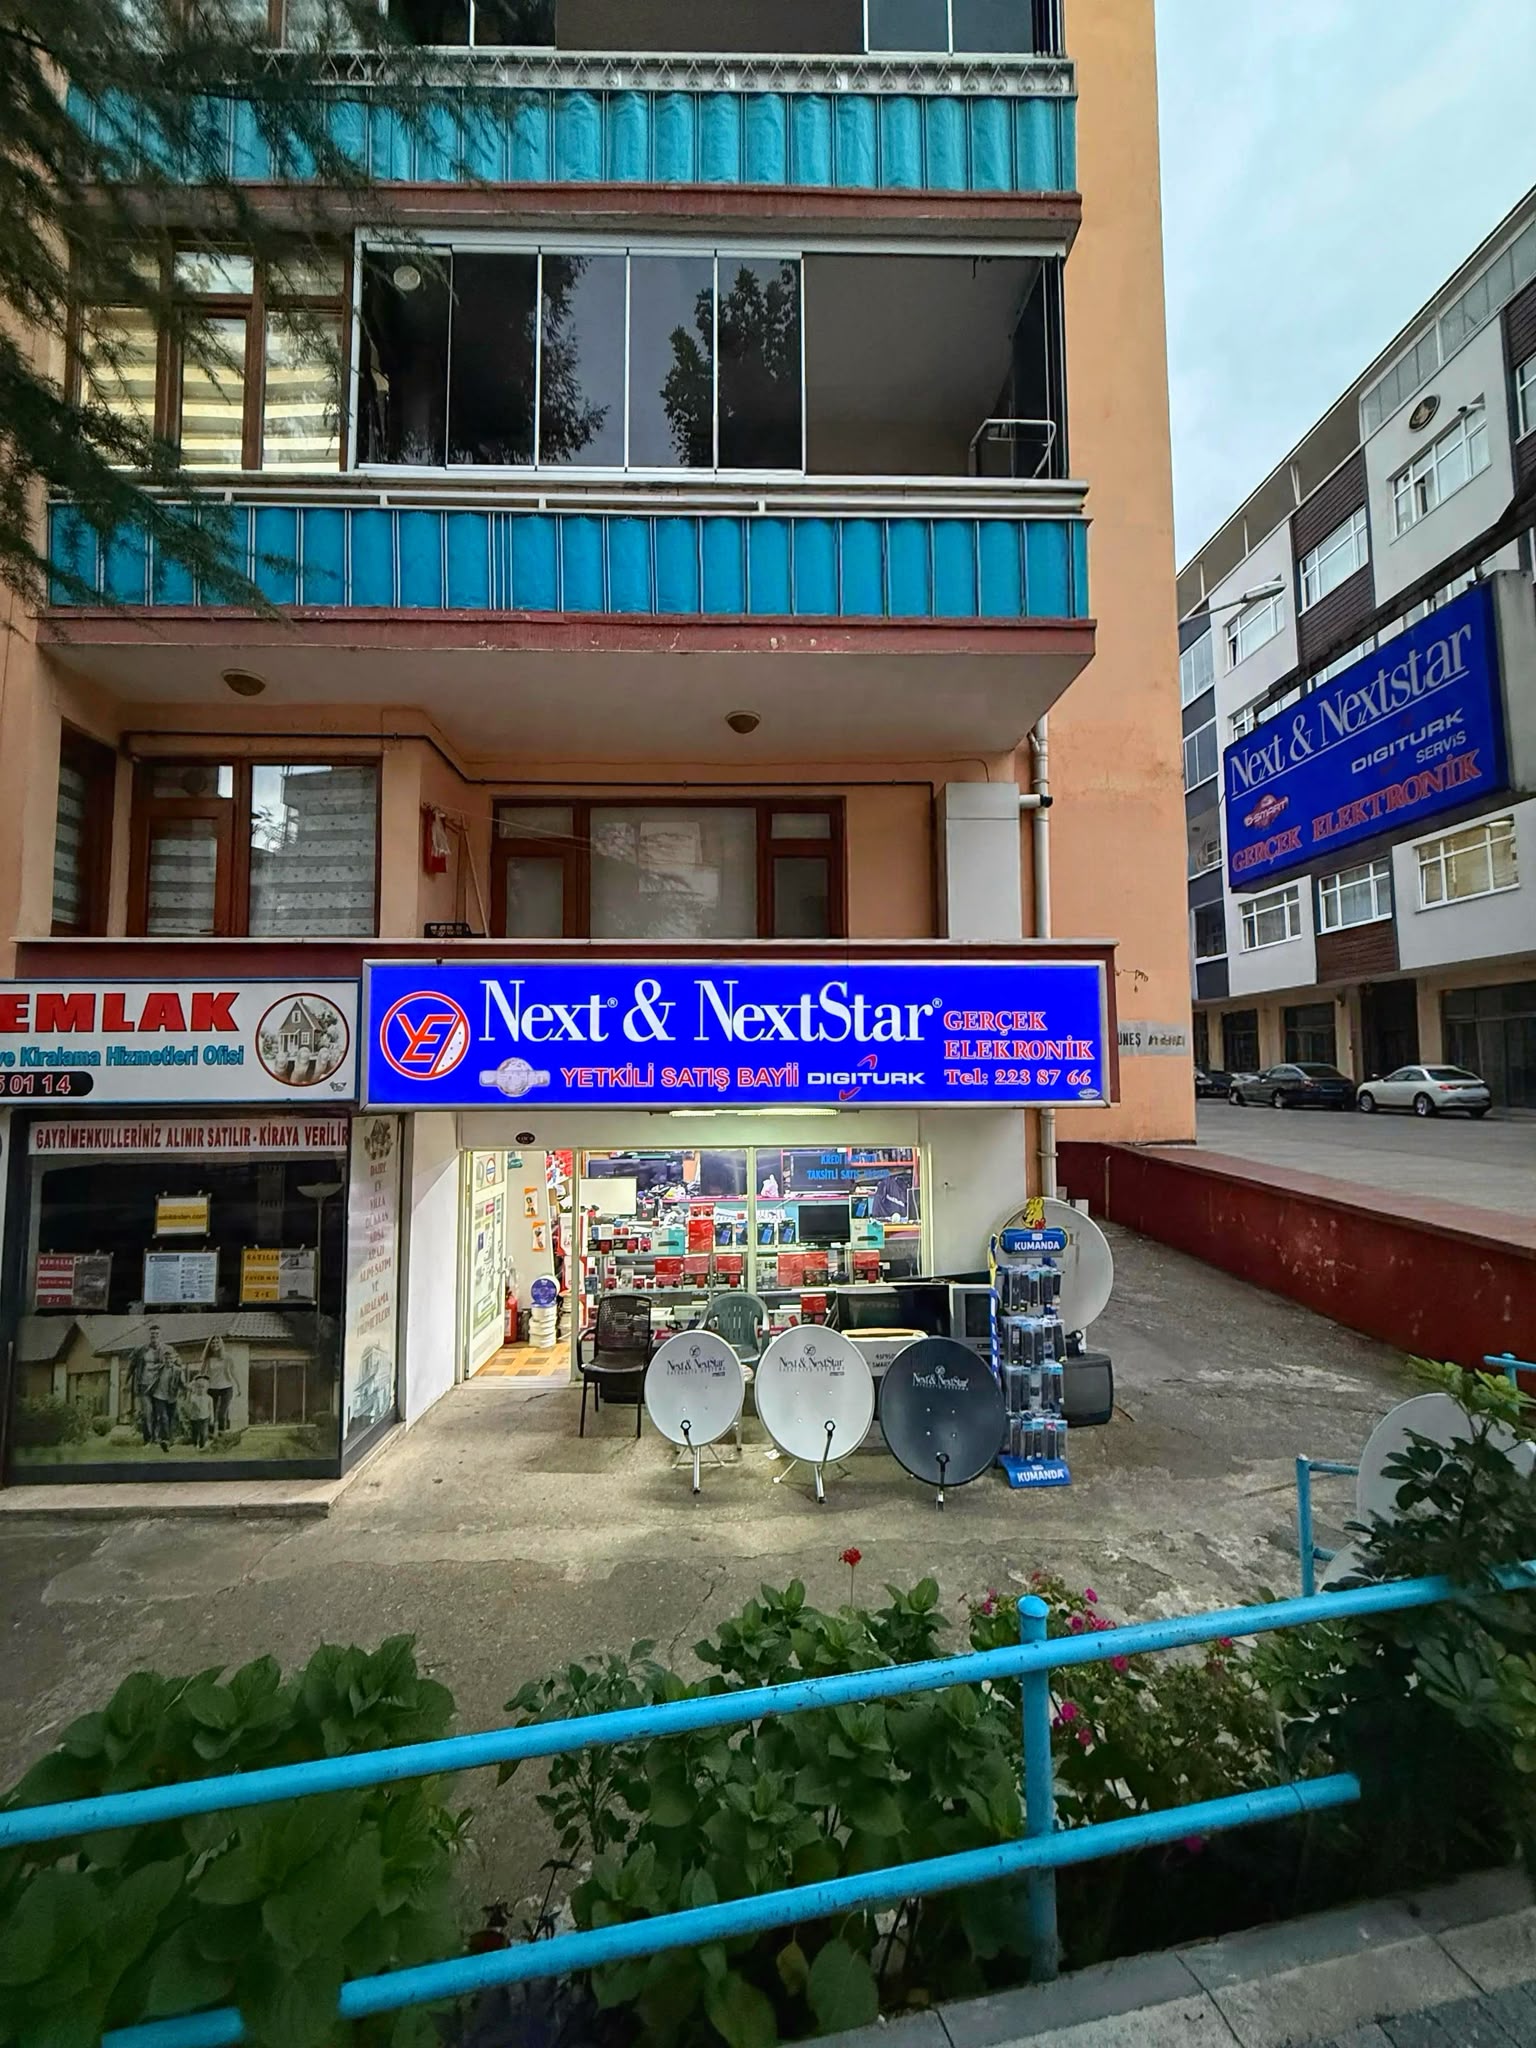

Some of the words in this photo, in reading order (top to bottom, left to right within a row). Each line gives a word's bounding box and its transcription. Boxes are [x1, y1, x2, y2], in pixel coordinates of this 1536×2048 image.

[1351, 708, 1463, 774] DIGITURK
[1230, 734, 1287, 795] Next
[1290, 714, 1313, 762] &
[1232, 825, 1302, 873] GERÇEK
[1312, 749, 1482, 842] ELEKTRONİK
[0, 992, 240, 1033] EMLAK
[622, 979, 676, 1042] &
[943, 1010, 1048, 1036] GERÇEK
[20, 1046, 101, 1067] Kiralama
[106, 1045, 197, 1066] Hizmetleri
[203, 1045, 244, 1066] Ofisi
[943, 1035, 1095, 1060] ELEKRONİK
[9, 1074, 34, 1094] 01
[42, 1074, 71, 1094] 14
[560, 1063, 654, 1087] YETKİLİ
[660, 1067, 730, 1092] SATIŞ
[807, 1072, 926, 1085] DIGITURK
[944, 1068, 989, 1086] Tel:
[994, 1069, 1030, 1086] 223
[1037, 1069, 1059, 1086] 87
[1066, 1069, 1092, 1086] 66
[35, 1122, 161, 1149] GAYRİMENKULLERİNİZ
[166, 1125, 204, 1147] ALINIR
[207, 1124, 251, 1147] SATILIR
[259, 1121, 300, 1147] KİRAYA
[304, 1120, 348, 1146] VERİLİR
[1014, 1240, 1060, 1251] KUMANDA
[1016, 1468, 1065, 1483] KUMANDA
